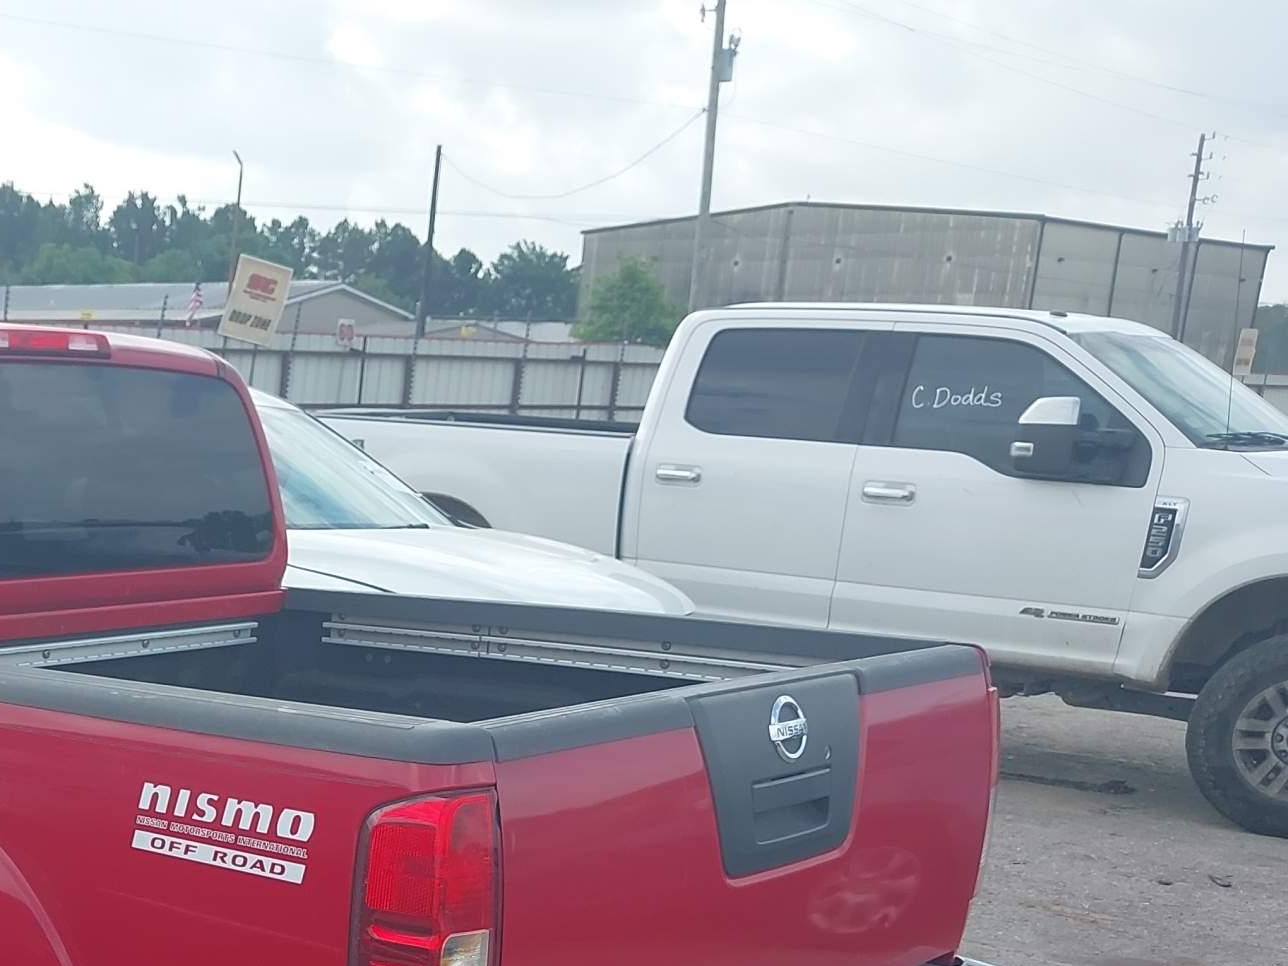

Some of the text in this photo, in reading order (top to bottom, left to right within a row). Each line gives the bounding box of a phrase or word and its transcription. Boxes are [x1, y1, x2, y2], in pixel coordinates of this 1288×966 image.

[933, 385, 1002, 408] Dodds
[776, 723, 808, 738] NISSAN
[136, 815, 309, 859] NISSAN MOTORSPORTS INTERNATIONAL
[150, 837, 286, 876] OFF ROAD
